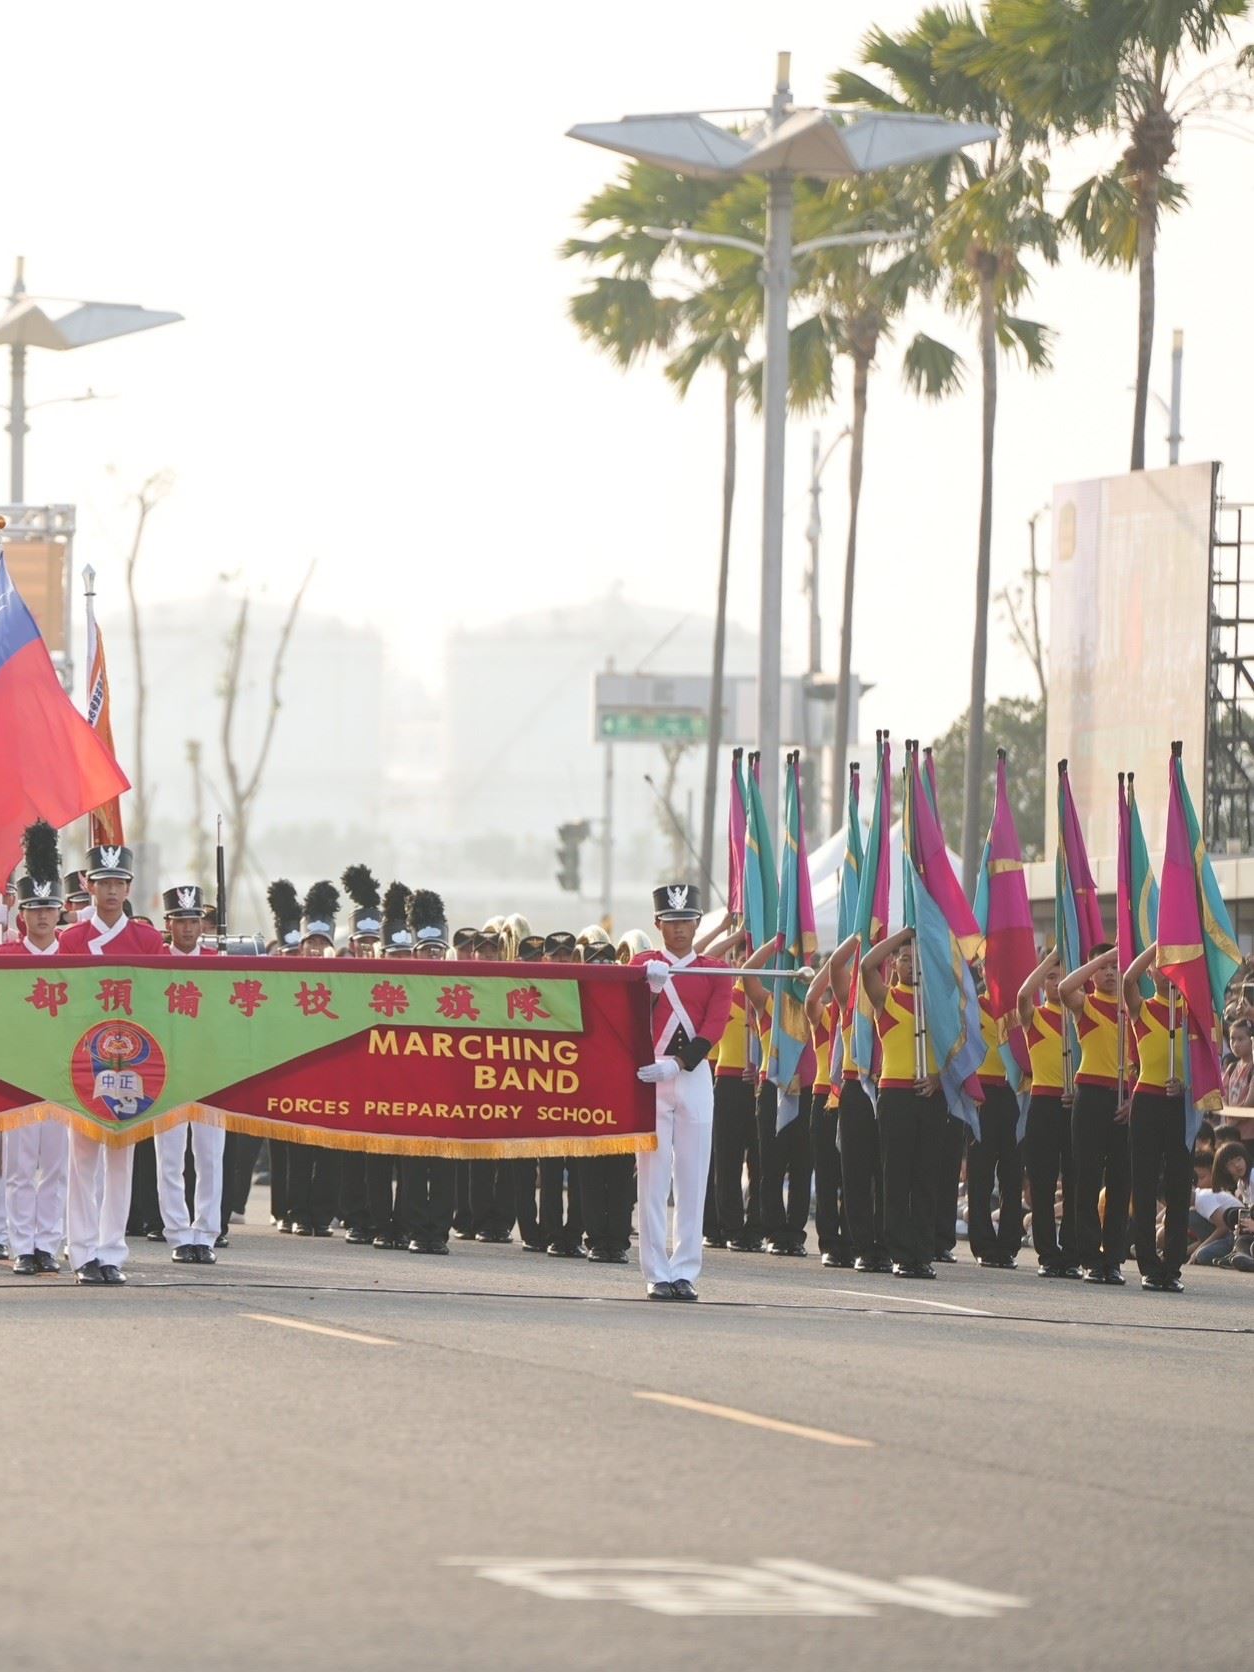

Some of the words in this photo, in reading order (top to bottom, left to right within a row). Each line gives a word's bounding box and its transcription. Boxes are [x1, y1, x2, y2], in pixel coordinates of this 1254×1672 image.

[368, 1029, 579, 1065] MARCHING
[102, 1073, 134, 1090] 中正
[474, 1064, 579, 1094] BAND
[267, 1098, 350, 1115] FORCES
[364, 1101, 523, 1120] PREPARATORY
[537, 1106, 618, 1125] SCHOOL
